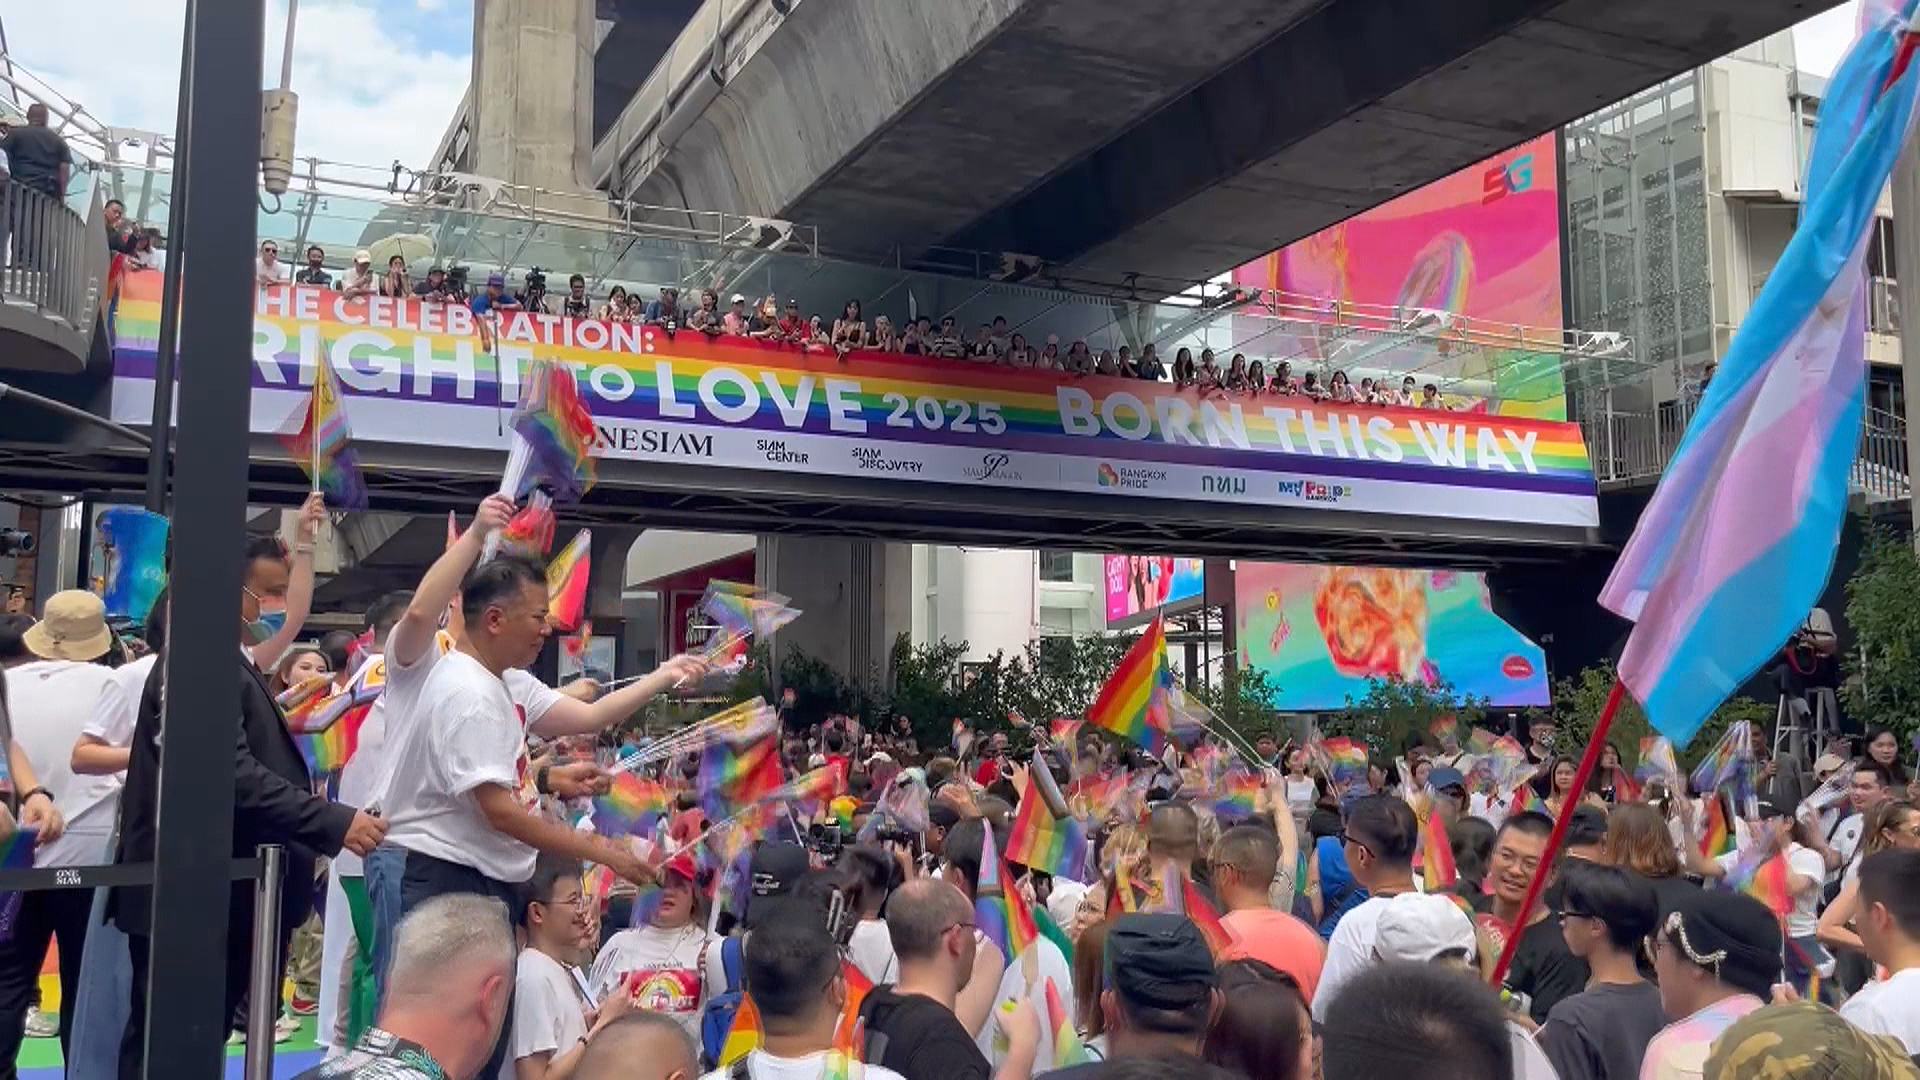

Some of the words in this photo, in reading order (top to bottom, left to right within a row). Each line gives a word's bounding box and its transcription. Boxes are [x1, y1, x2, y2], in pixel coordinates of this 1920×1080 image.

[1482, 154, 1533, 205] 5G
[257, 284, 320, 321] HE
[253, 318, 534, 402] RIGHT
[655, 361, 867, 433] LOVE
[882, 391, 1007, 435] 2025
[1057, 386, 1251, 449] BORN
[1263, 406, 1404, 463] THIS
[1408, 419, 1539, 475] WAY
[599, 426, 714, 457] NESIAM
[756, 439, 786, 452] SIAM
[766, 450, 809, 465] CENTER
[852, 447, 882, 459] SIAM
[858, 457, 923, 473] DISCOVERY
[1120, 468, 1167, 481] BANGKOK
[1120, 479, 1149, 489] PRIDE
[1202, 475, 1246, 494] กทม
[56, 869, 81, 877] ONE
[56, 877, 81, 885] SIAM
